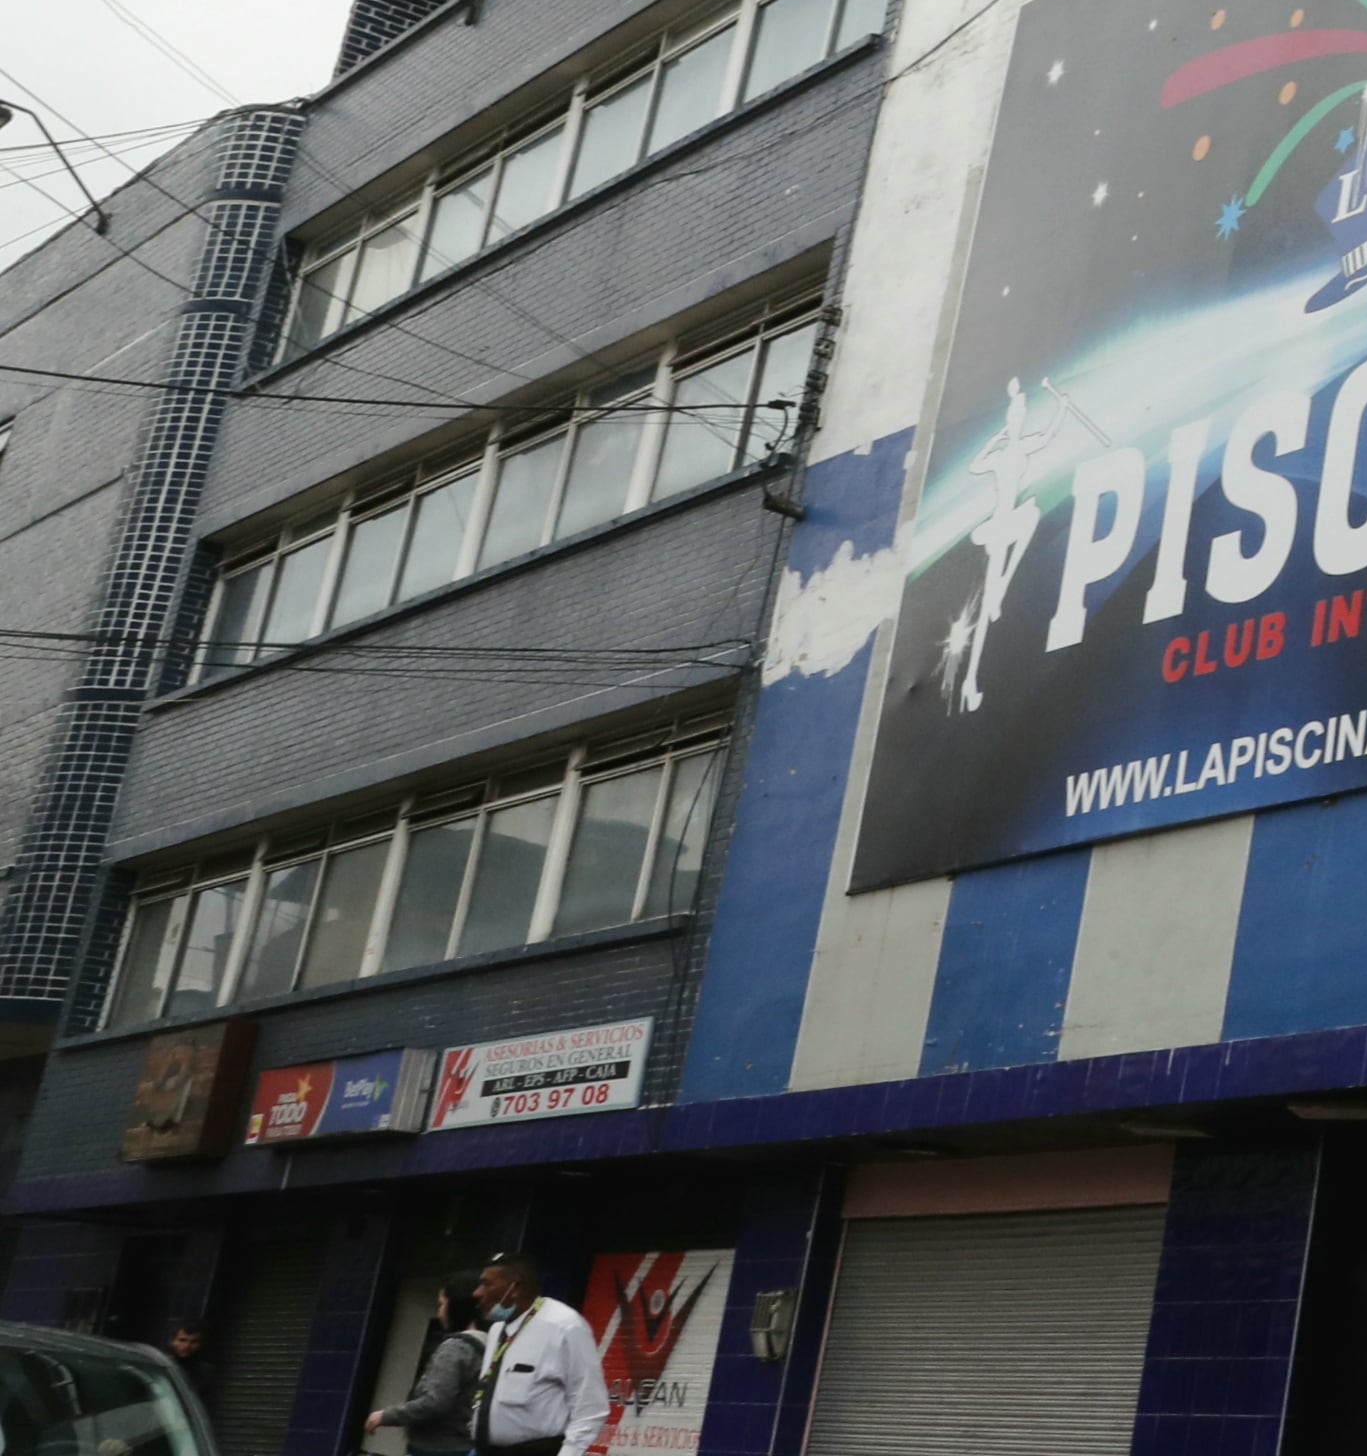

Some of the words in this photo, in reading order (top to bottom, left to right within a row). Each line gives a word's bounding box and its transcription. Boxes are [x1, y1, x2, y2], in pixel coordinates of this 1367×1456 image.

[1162, 610, 1287, 683] CLUB
[570, 1024, 645, 1049] SERVICIOS
[486, 1056, 544, 1076] SEGUROS
[547, 1052, 565, 1068] EN
[567, 1043, 633, 1065] GENERAL
[585, 1064, 617, 1079] CAJA
[502, 1092, 540, 1115] 703
[547, 1087, 576, 1110] 97
[581, 1083, 610, 1106] 08
